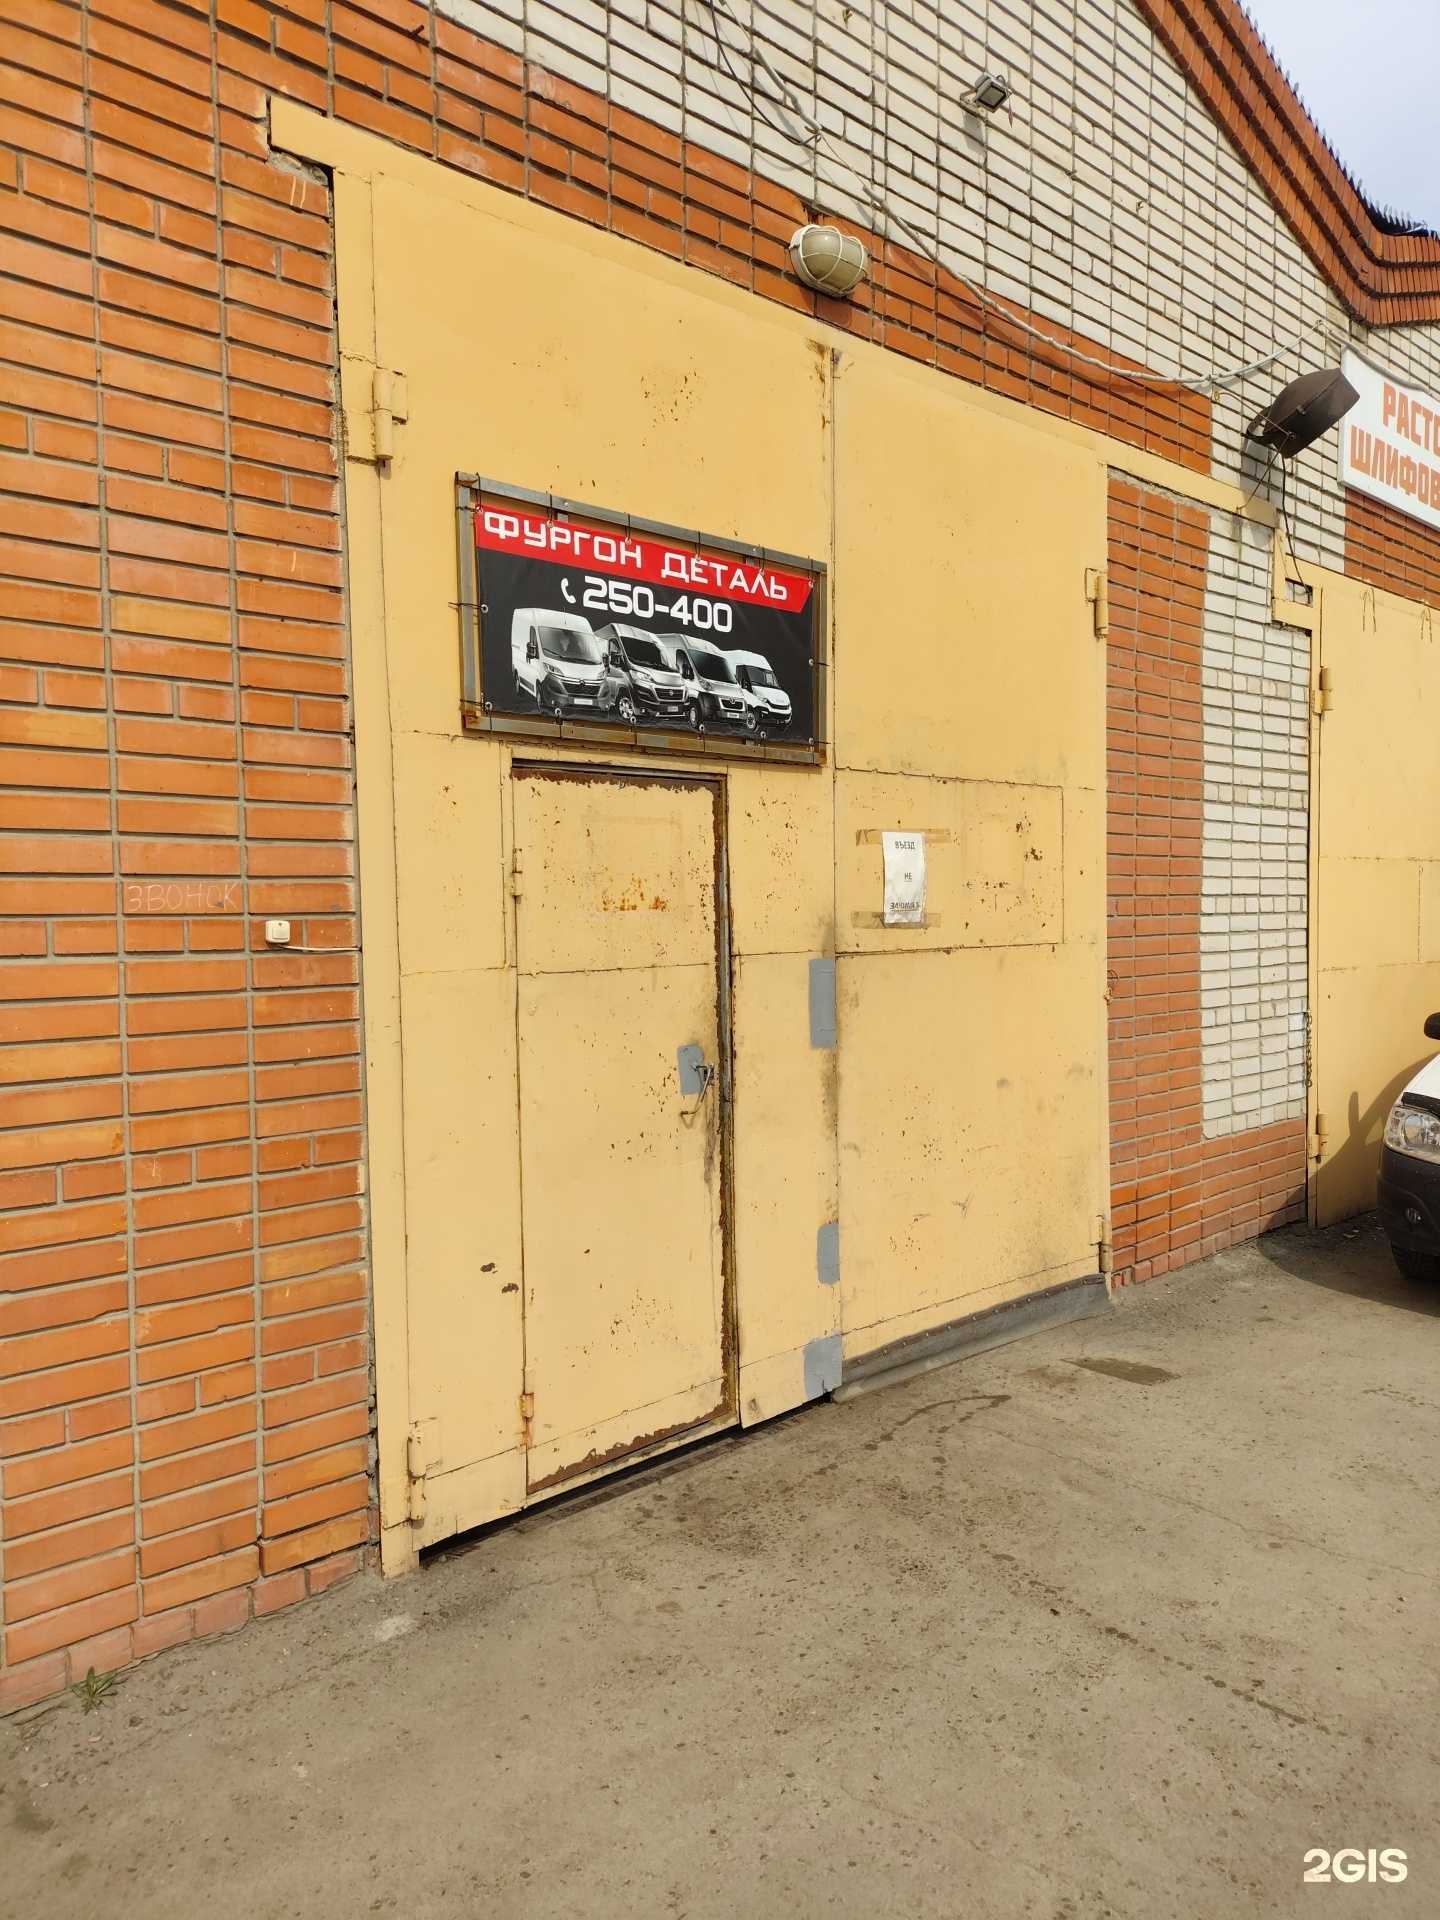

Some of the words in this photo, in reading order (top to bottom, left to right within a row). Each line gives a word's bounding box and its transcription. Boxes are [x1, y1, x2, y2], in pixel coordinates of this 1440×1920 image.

[1350, 424, 1440, 511] ШЛИФОВ
[484, 512, 642, 568] ФУРГОН
[661, 552, 788, 601] ДЕТАЛЬ
[583, 576, 733, 632] 250-400
[127, 882, 239, 911] ЗВОНОК
[904, 872, 912, 880] НЕ
